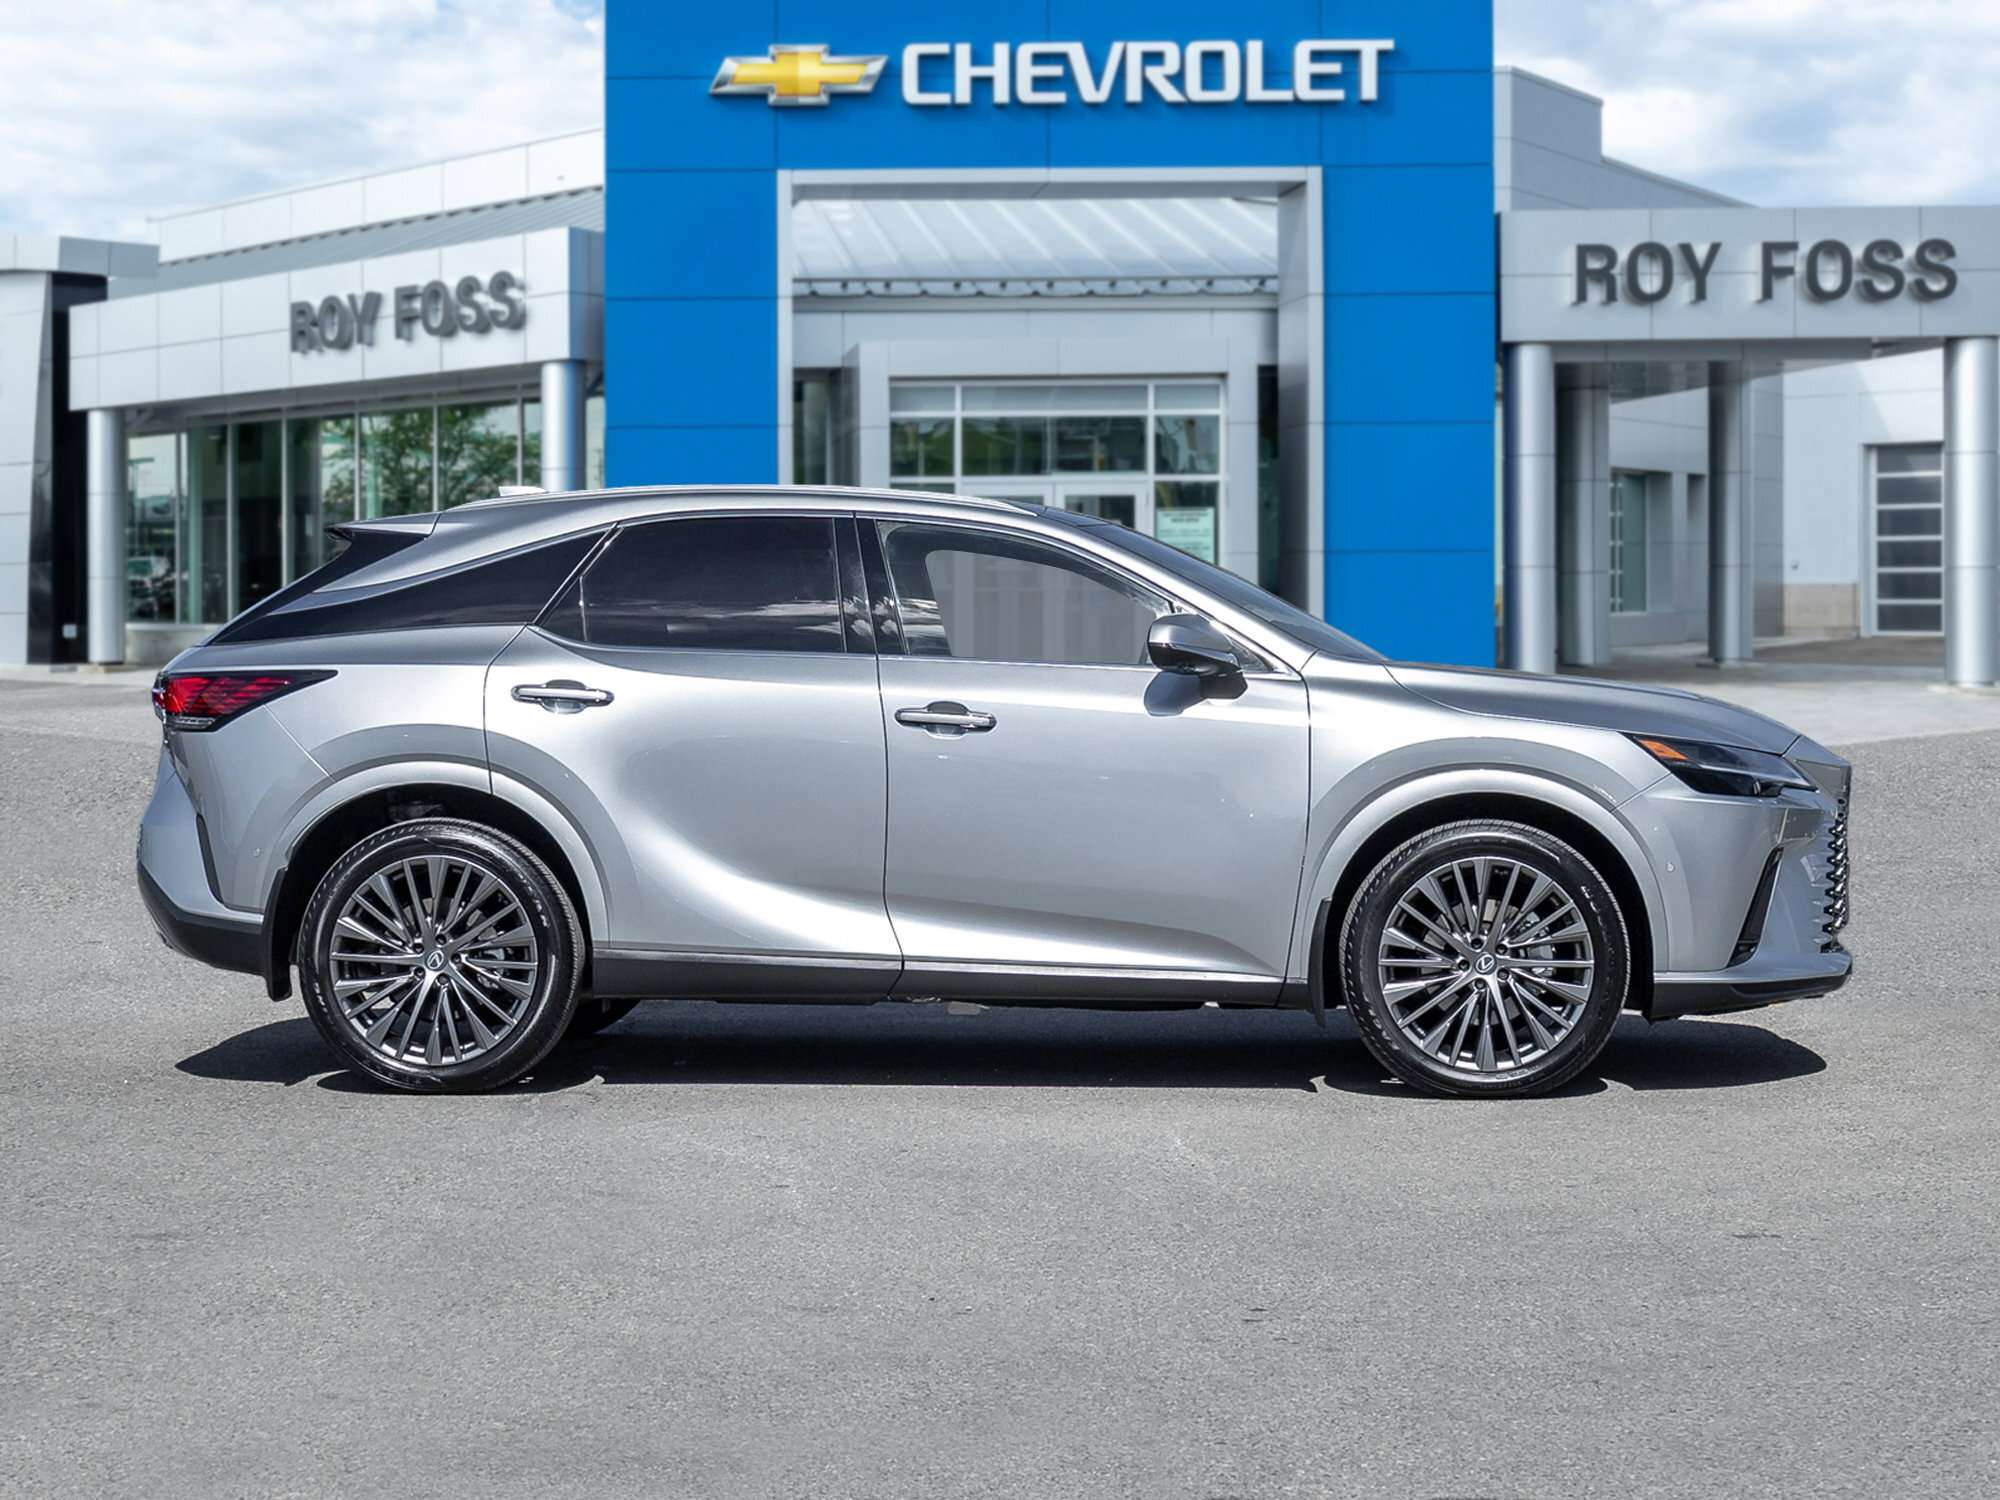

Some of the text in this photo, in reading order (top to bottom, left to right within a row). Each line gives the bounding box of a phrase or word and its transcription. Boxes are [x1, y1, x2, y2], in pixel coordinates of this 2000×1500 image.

[902, 39, 1395, 104] CHEVROLET
[1573, 238, 1958, 304] ROY FOSS
[290, 270, 527, 355] ROY FOSS
